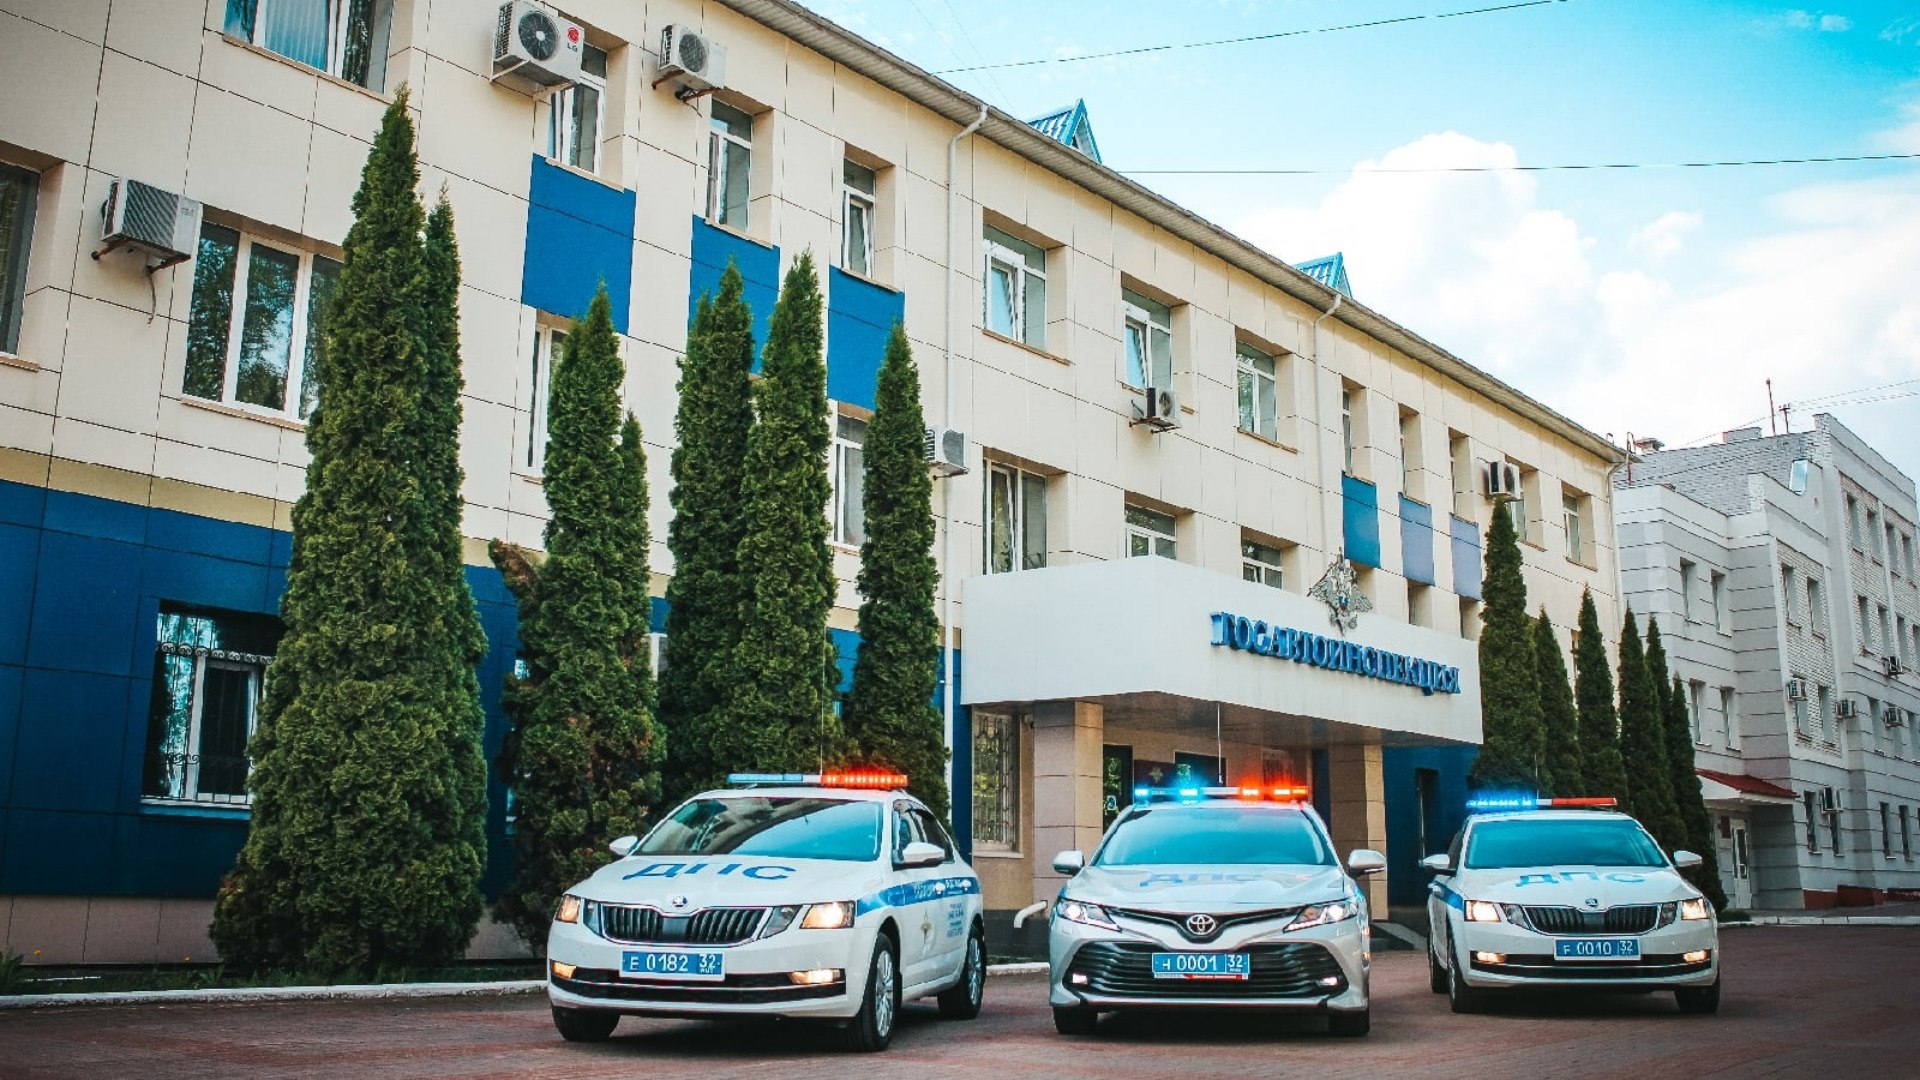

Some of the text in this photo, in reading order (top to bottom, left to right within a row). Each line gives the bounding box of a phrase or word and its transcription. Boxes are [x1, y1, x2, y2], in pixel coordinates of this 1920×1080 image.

[567, 42, 578, 53] LG
[622, 863, 797, 880] ДПС
[1515, 871, 1646, 888] ДПС
[1577, 941, 1612, 955] 0010
[1620, 940, 1633, 952] 32
[646, 953, 689, 972] 0182
[699, 953, 716, 968] 32
[1176, 954, 1218, 972] 0001
[1227, 954, 1243, 968] 32
